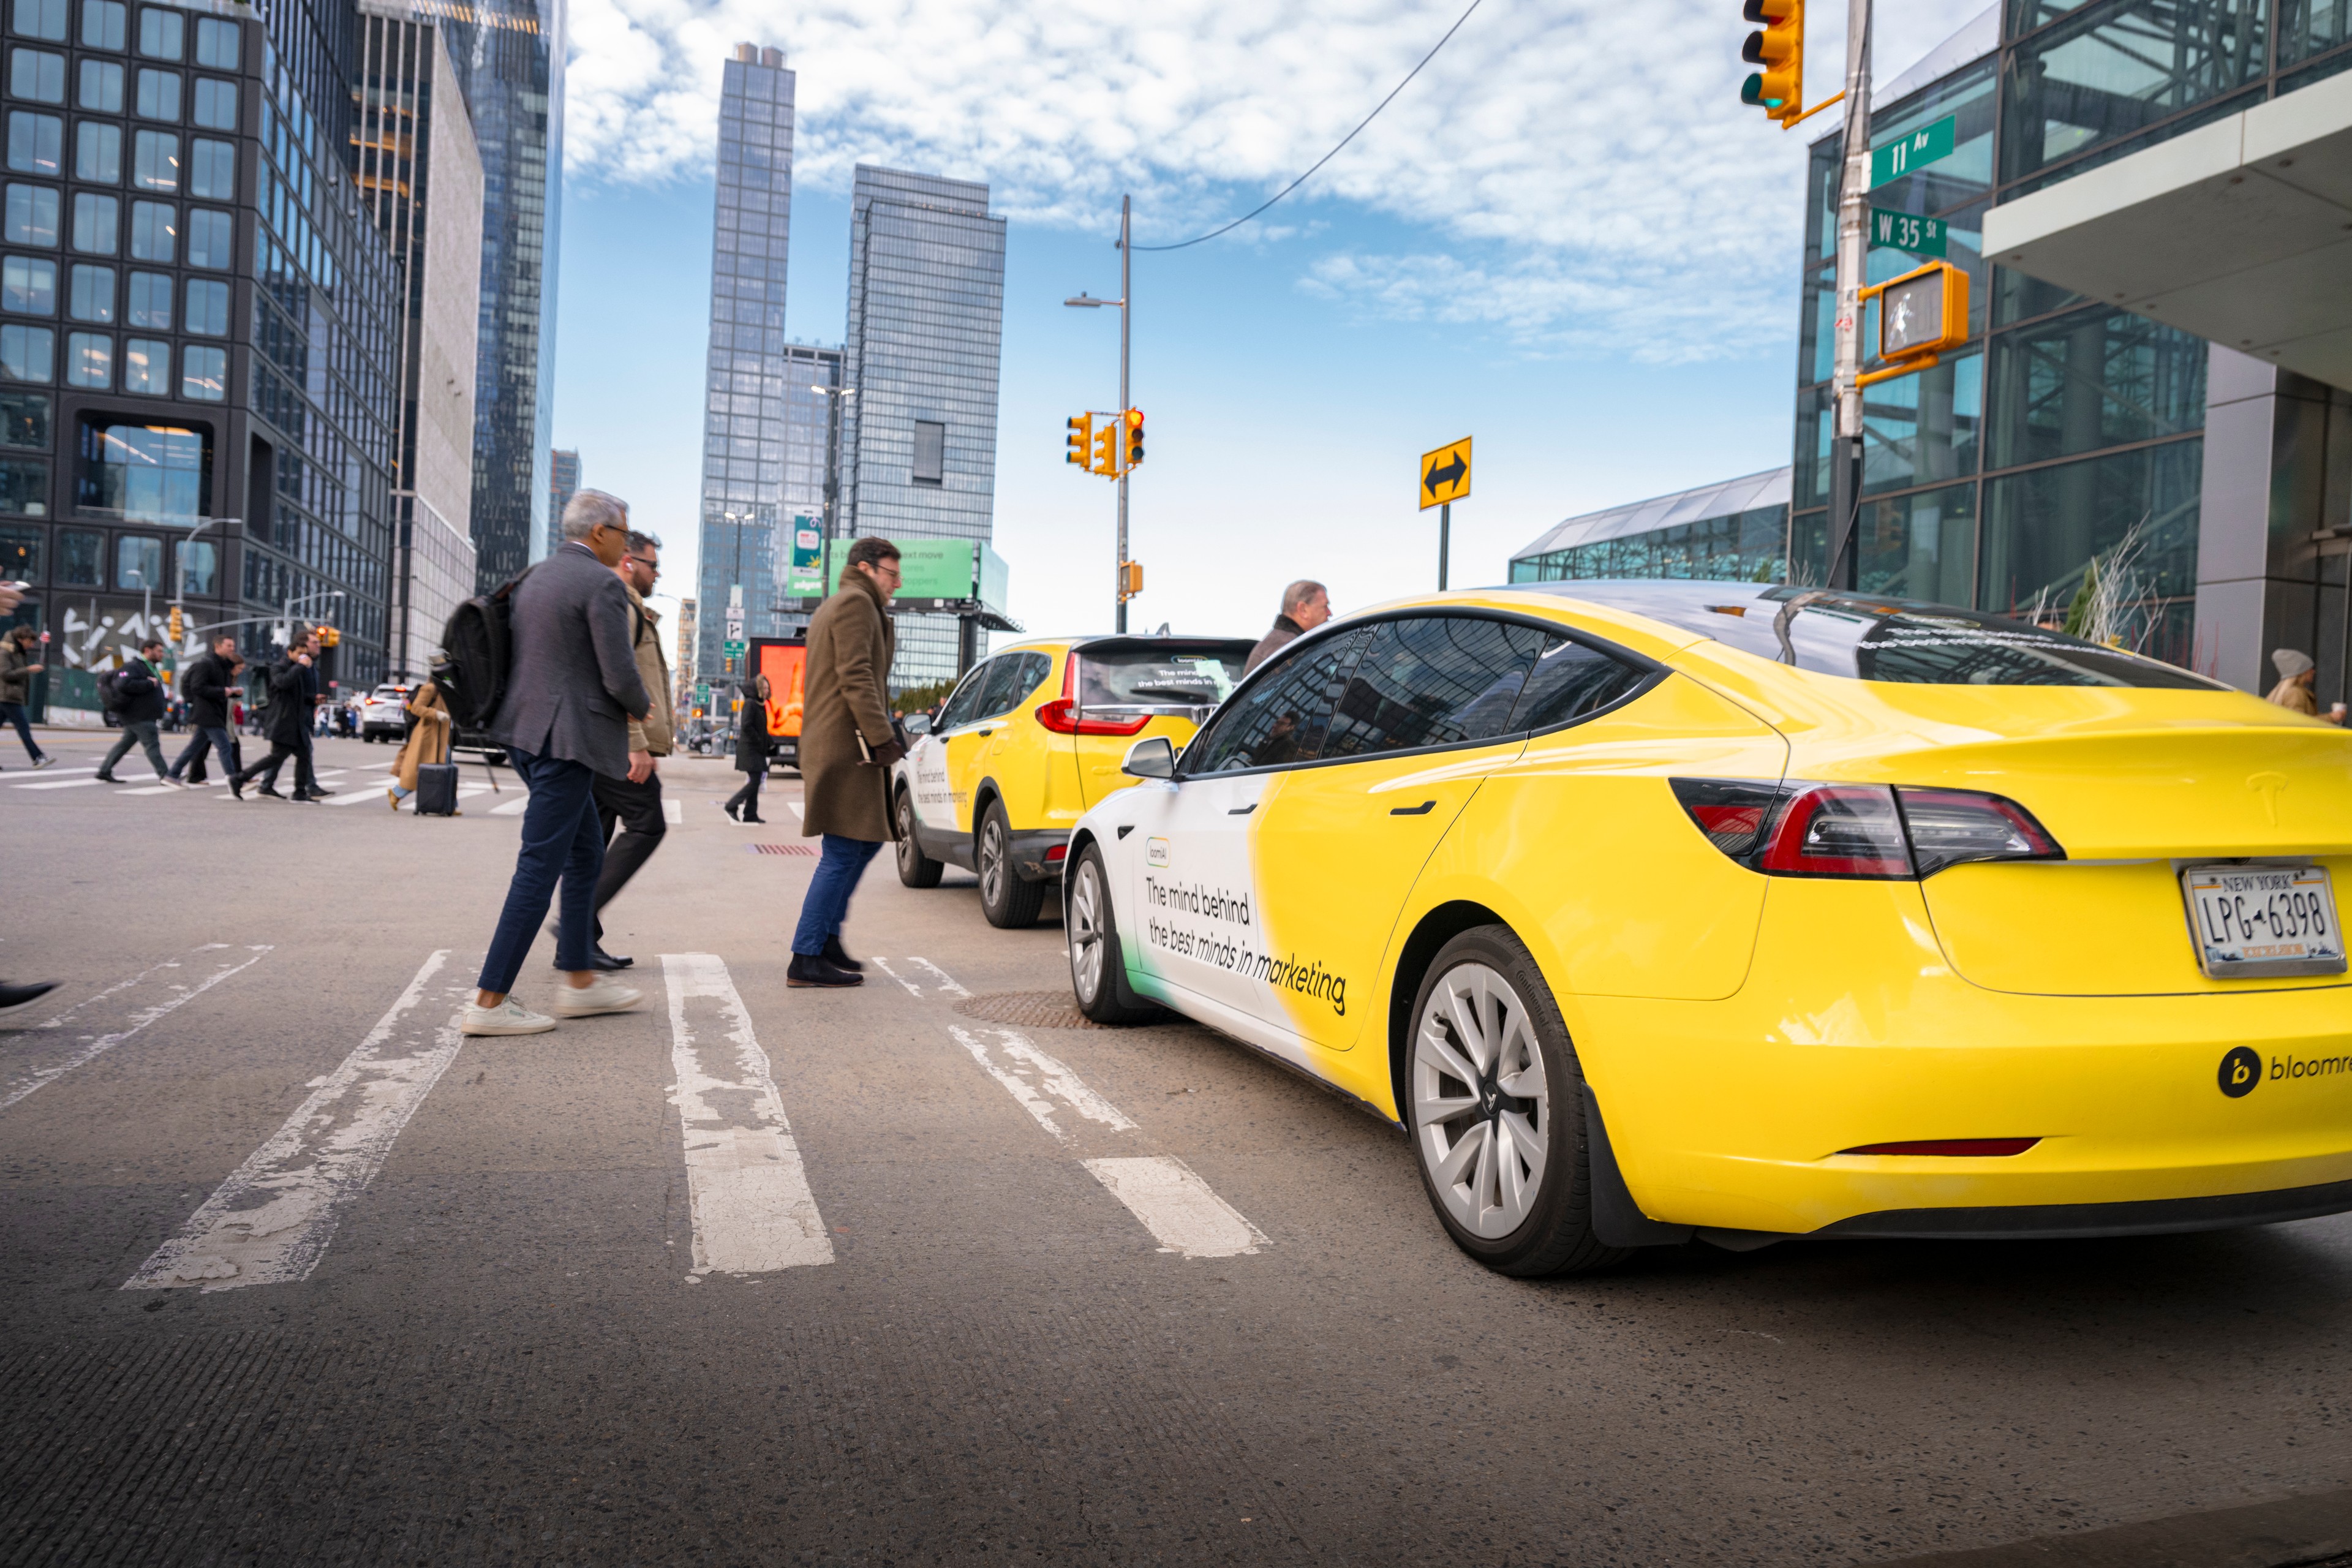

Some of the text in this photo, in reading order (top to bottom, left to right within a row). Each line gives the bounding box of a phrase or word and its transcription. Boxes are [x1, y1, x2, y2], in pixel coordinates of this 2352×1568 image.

[1892, 132, 1929, 175] 11 Av
[1879, 213, 1937, 248] W 35 St
[1147, 876, 1250, 925] The mind behind
[2222, 874, 2293, 892] NEW YORK
[1149, 916, 1346, 1016] the best minds in marketing
[1516, 970, 1550, 1027] Continental
[2269, 1054, 2352, 1080] bloomr
